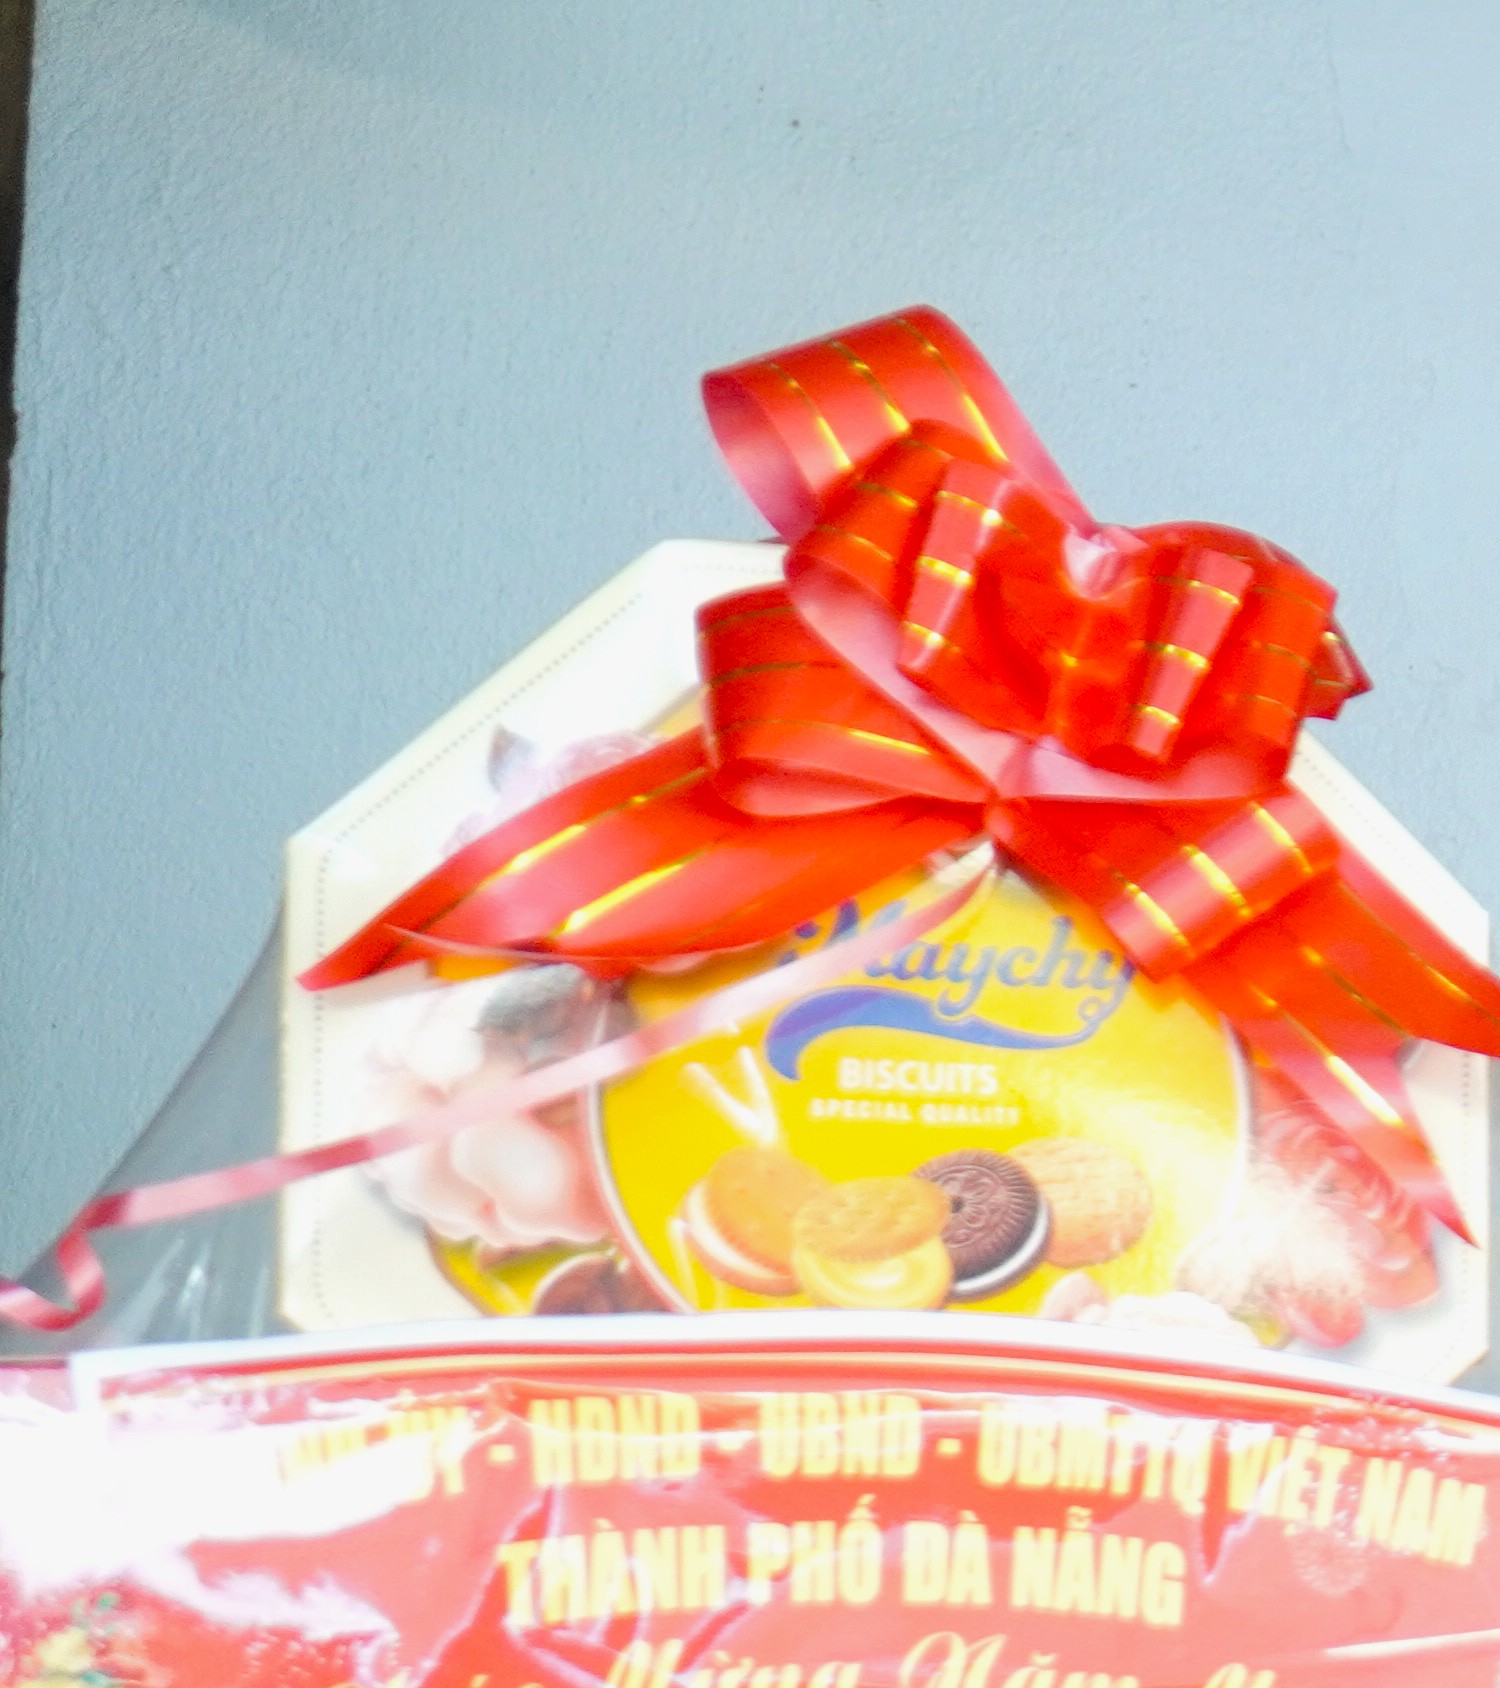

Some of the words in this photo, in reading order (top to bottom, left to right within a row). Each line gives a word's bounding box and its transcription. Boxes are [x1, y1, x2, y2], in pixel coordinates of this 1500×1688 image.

[808, 1096, 913, 1122] SPECIAL
[919, 1102, 1021, 1127] QUALITY
[838, 1056, 998, 1095] BISCUITS
[758, 1391, 922, 1479] UBND
[1227, 1422, 1352, 1538] VIỆT
[1356, 1455, 1487, 1567] NAM
[498, 1517, 727, 1630] THÀNH
[745, 1493, 883, 1607] PHỐ
[1010, 1505, 1188, 1628] NẴNG
